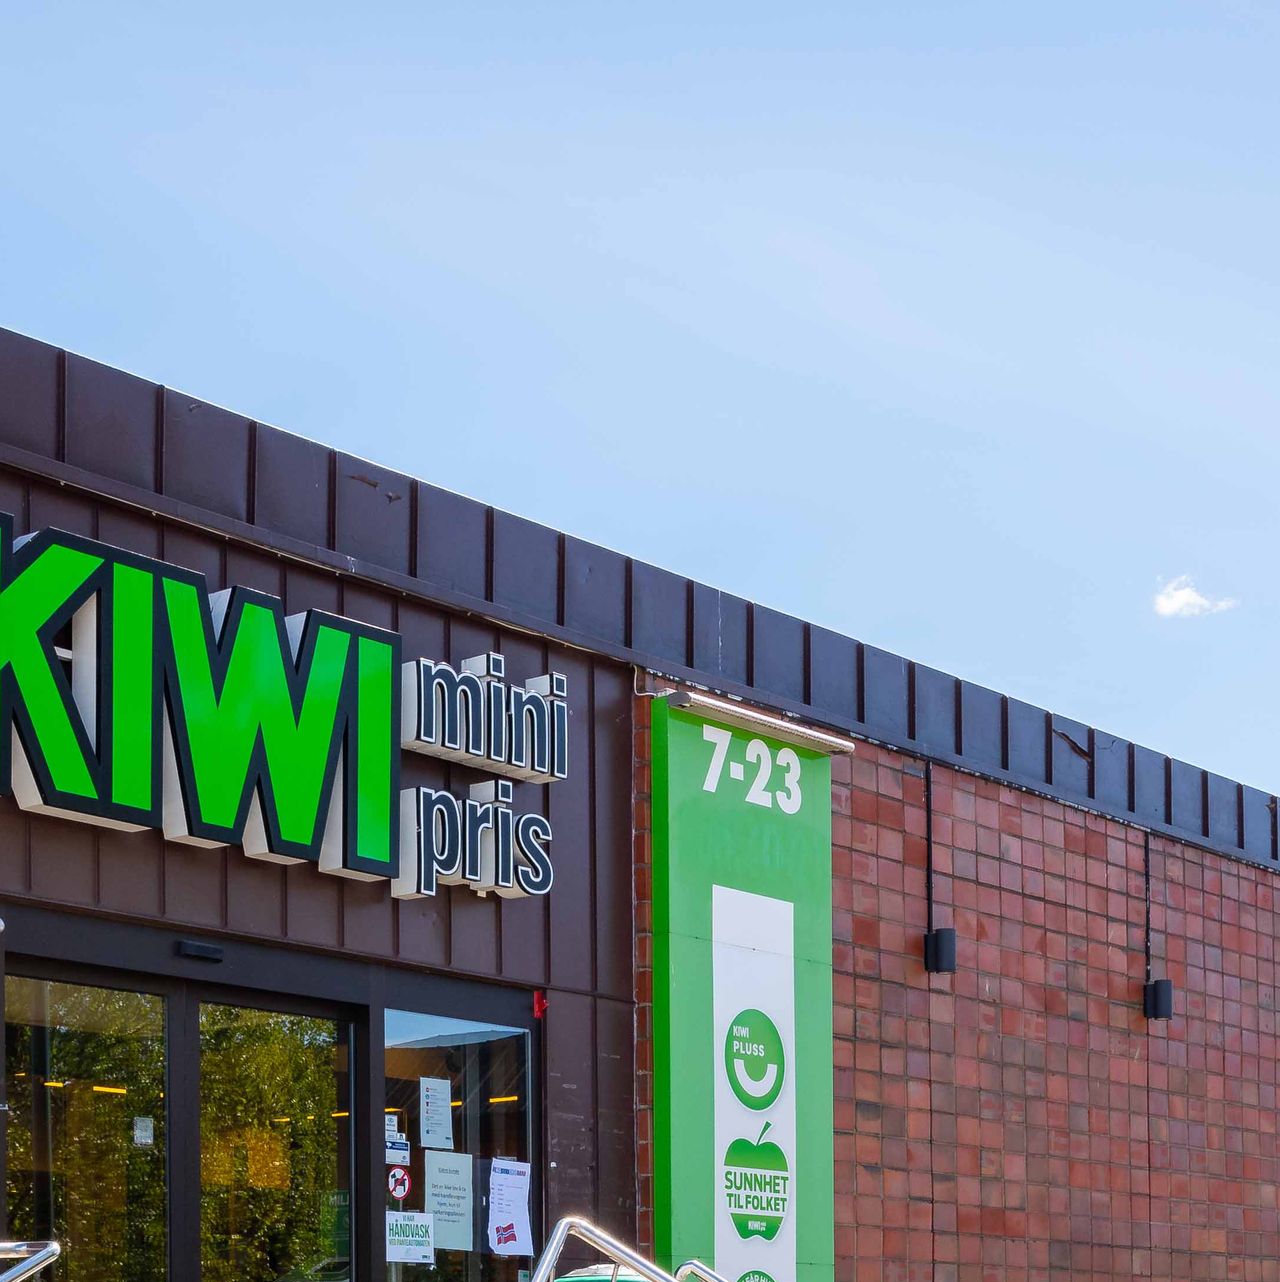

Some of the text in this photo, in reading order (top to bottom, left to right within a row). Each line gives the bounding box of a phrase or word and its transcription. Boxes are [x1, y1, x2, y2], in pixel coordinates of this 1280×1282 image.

[418, 652, 568, 780] mini
[703, 723, 802, 815] 7-23
[418, 779, 554, 897] pris
[733, 1025, 749, 1039] KIWI
[733, 1040, 765, 1057] PLUSS
[724, 1170, 789, 1195] SUNNHET
[726, 1192, 788, 1213] TIL FOLKET
[388, 1219, 430, 1239] HÅNDVASK
